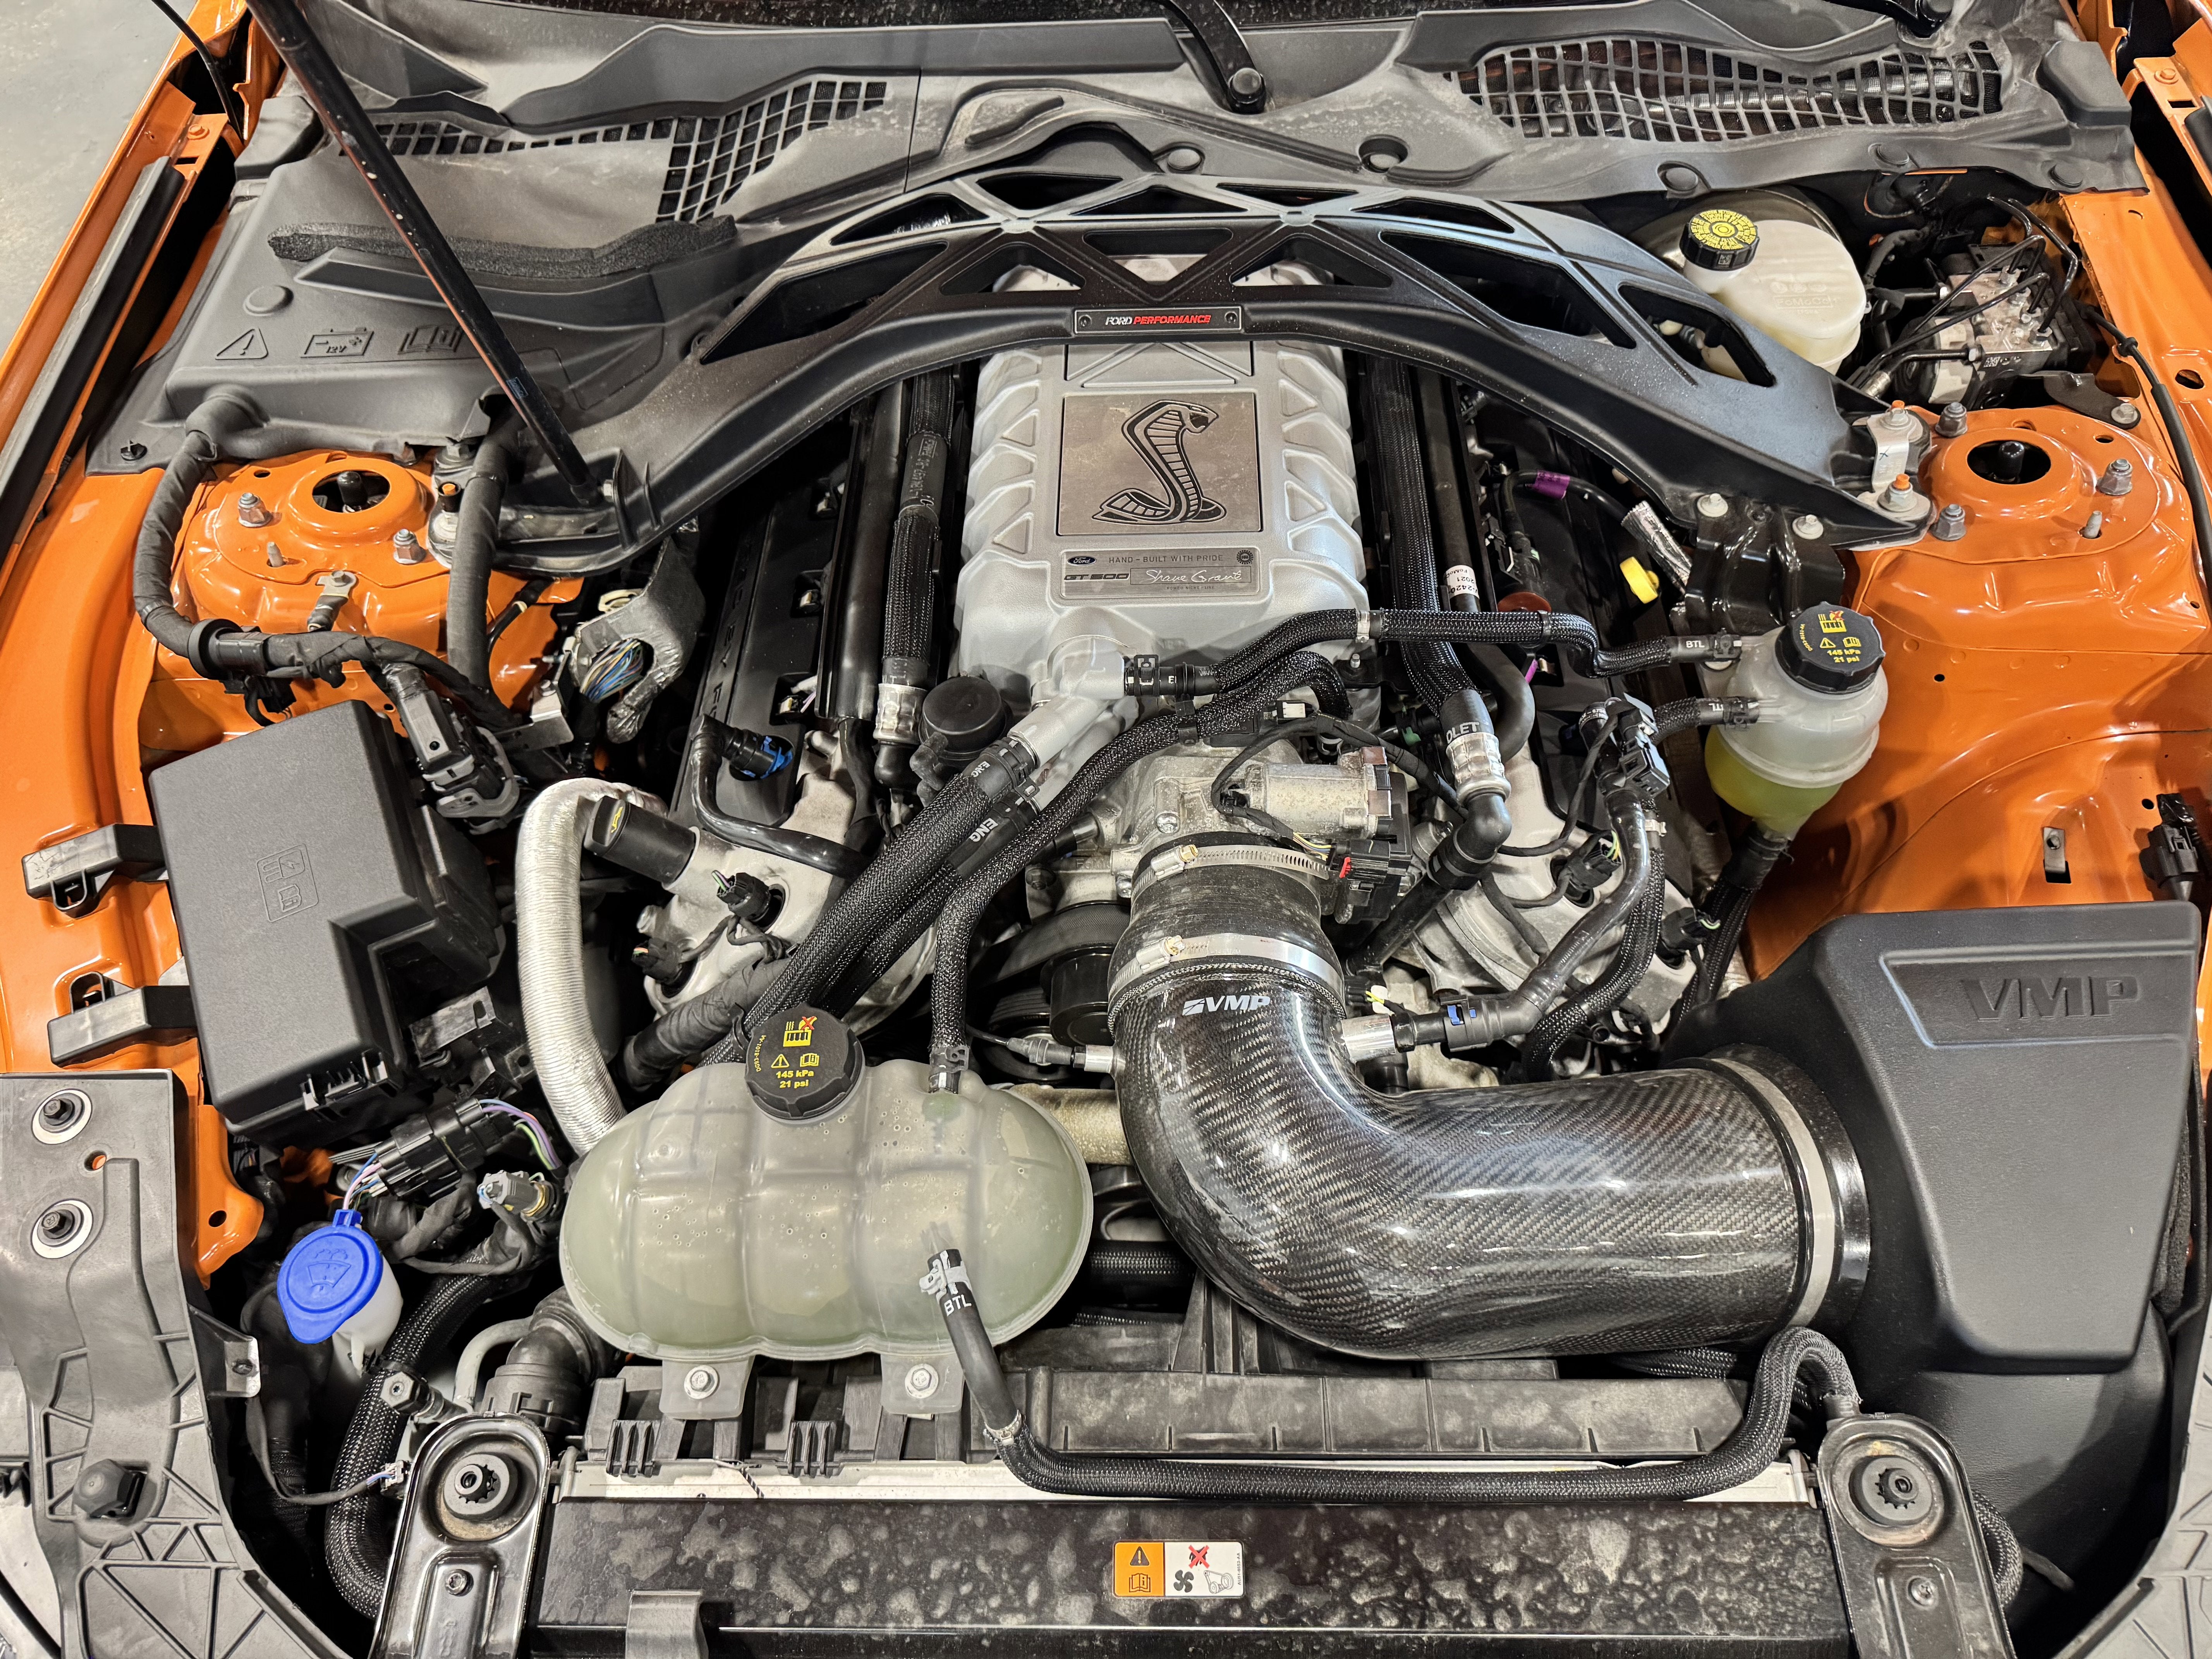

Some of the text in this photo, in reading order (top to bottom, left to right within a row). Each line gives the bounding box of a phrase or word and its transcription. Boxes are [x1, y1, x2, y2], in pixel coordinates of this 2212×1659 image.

[1105, 315, 1211, 325] FORD PERFORMANCE
[1686, 640, 1705, 648] BTL
[1446, 721, 1480, 744] OLET
[970, 761, 991, 778] ENG
[969, 817, 999, 842] ENG
[1206, 995, 1271, 1012] VMP
[1960, 976, 2140, 1022] VMP
[776, 1070, 793, 1079] 145
[779, 1080, 809, 1089] 21 psi
[944, 1294, 972, 1317] BTL
